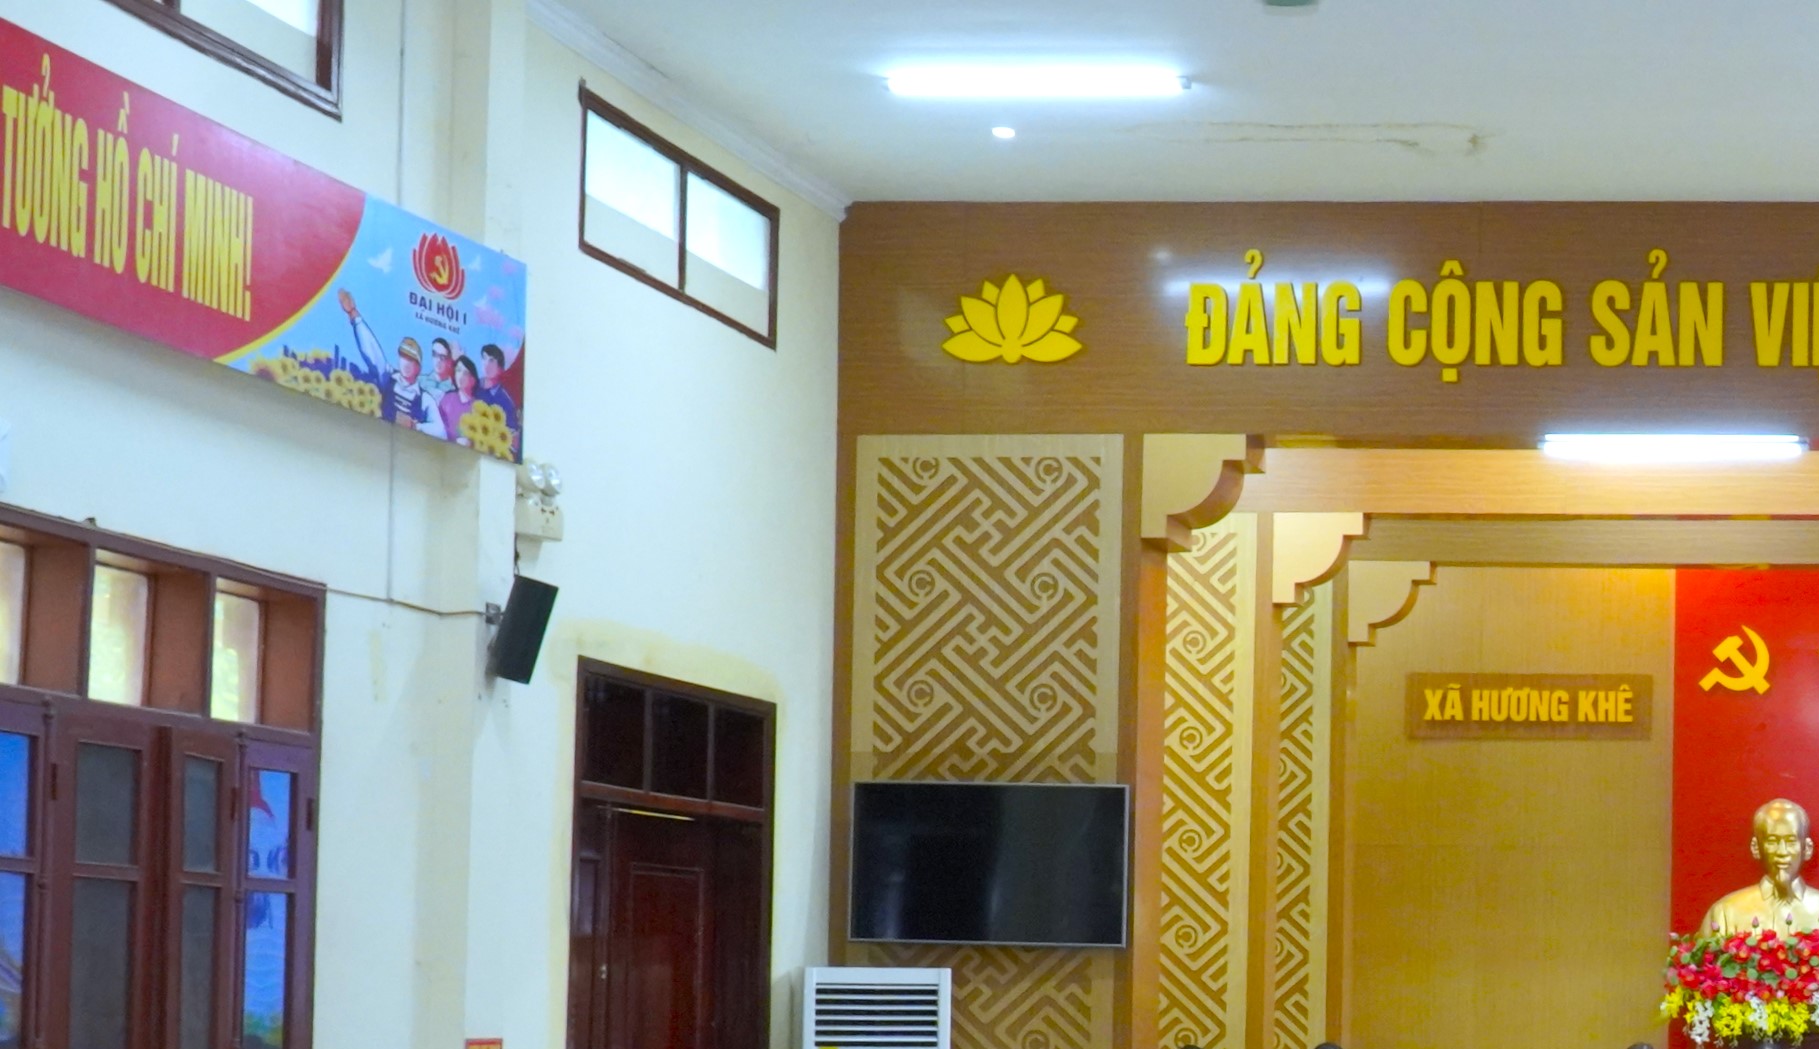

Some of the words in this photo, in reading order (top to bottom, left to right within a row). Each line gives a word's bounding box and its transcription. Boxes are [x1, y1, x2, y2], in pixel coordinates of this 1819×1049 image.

[2, 53, 89, 258] TƯỞNG
[93, 91, 130, 275] HỒ
[135, 133, 179, 293] CHÍ
[182, 168, 253, 322] MINH!
[1185, 249, 1362, 367] ĐẢNG
[1387, 260, 1563, 383] CỘNG
[1590, 249, 1724, 367] SẢN
[1423, 683, 1464, 721] XÃ
[1471, 687, 1570, 723] HƯƠNG
[1577, 684, 1634, 723] KHÊ
